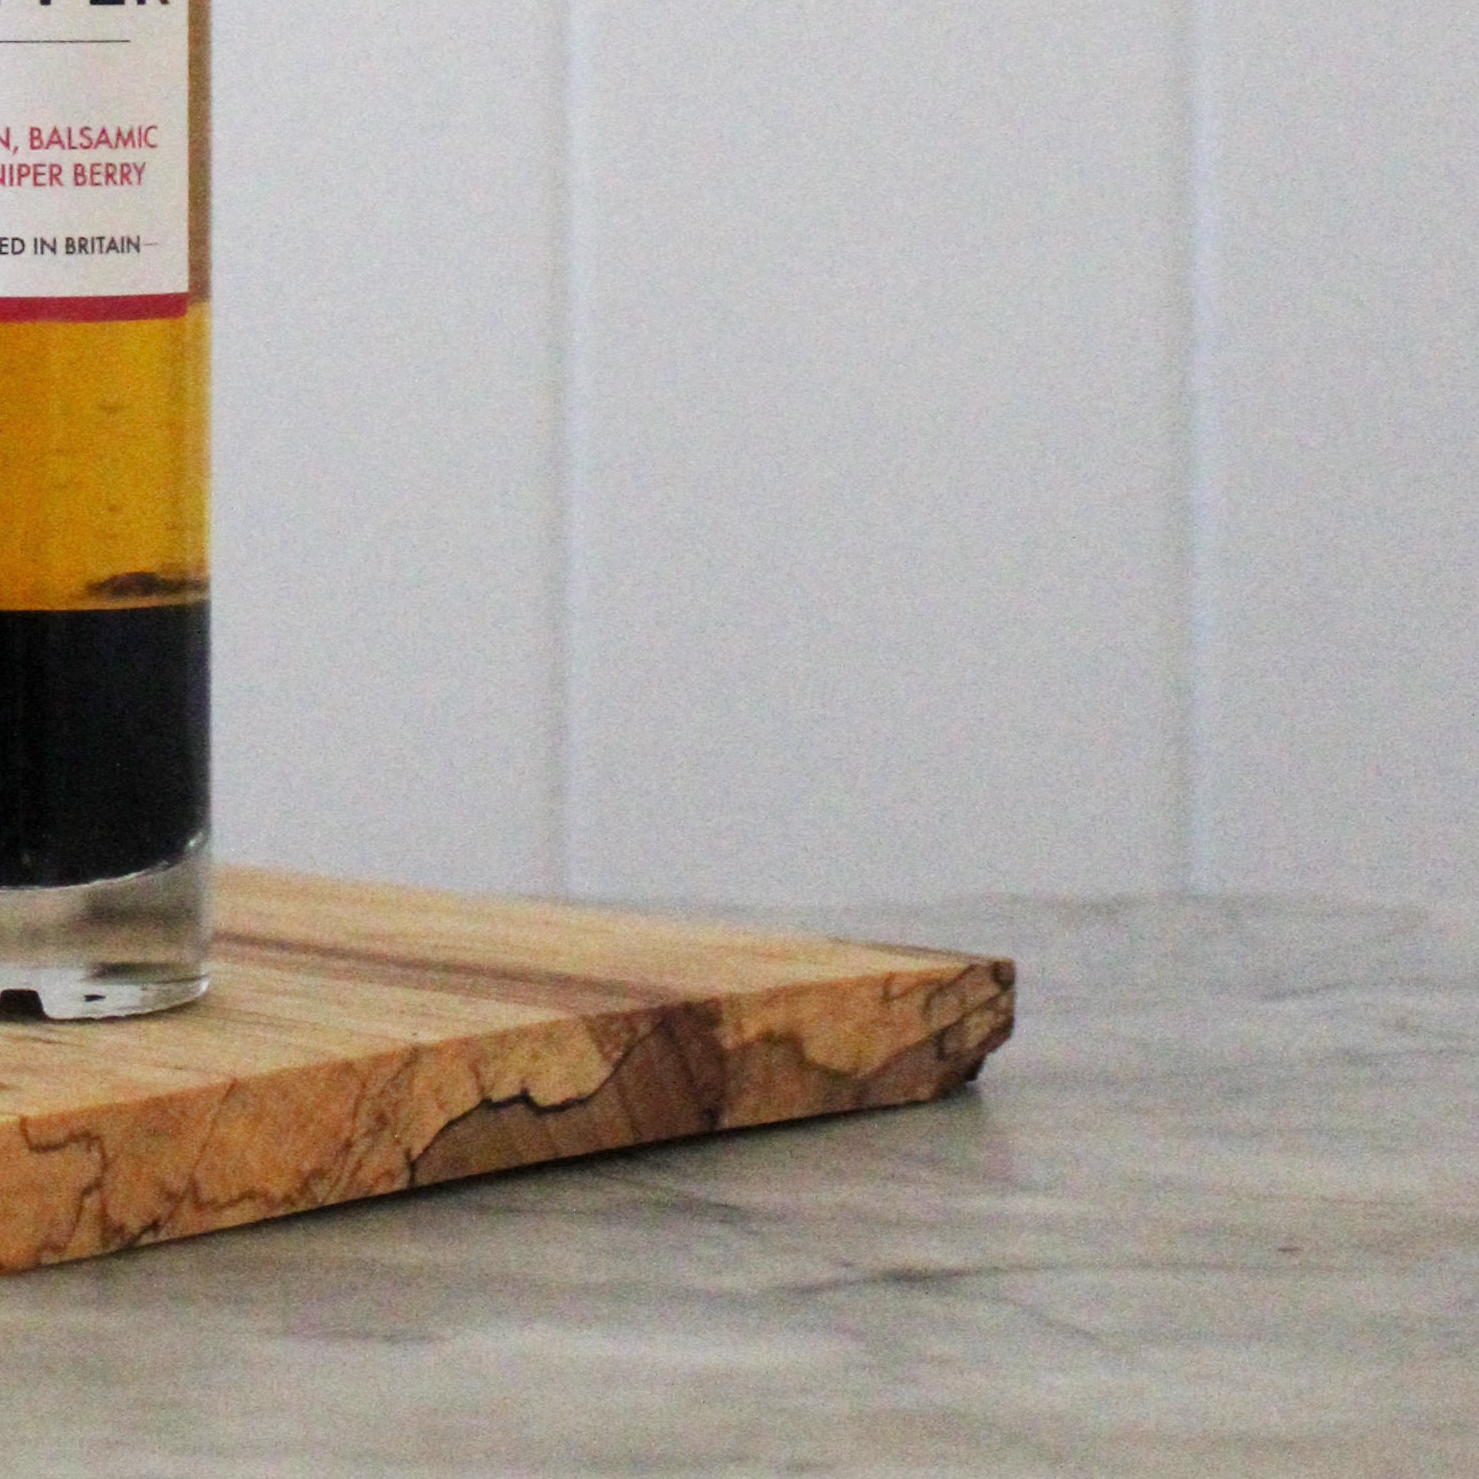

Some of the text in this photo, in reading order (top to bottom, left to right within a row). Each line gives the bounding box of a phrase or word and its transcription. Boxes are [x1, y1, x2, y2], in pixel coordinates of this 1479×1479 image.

[29, 124, 159, 151] BALSAMIC
[73, 162, 148, 187] BERRY
[33, 236, 57, 255] IN
[65, 235, 142, 255] BRITAIN
